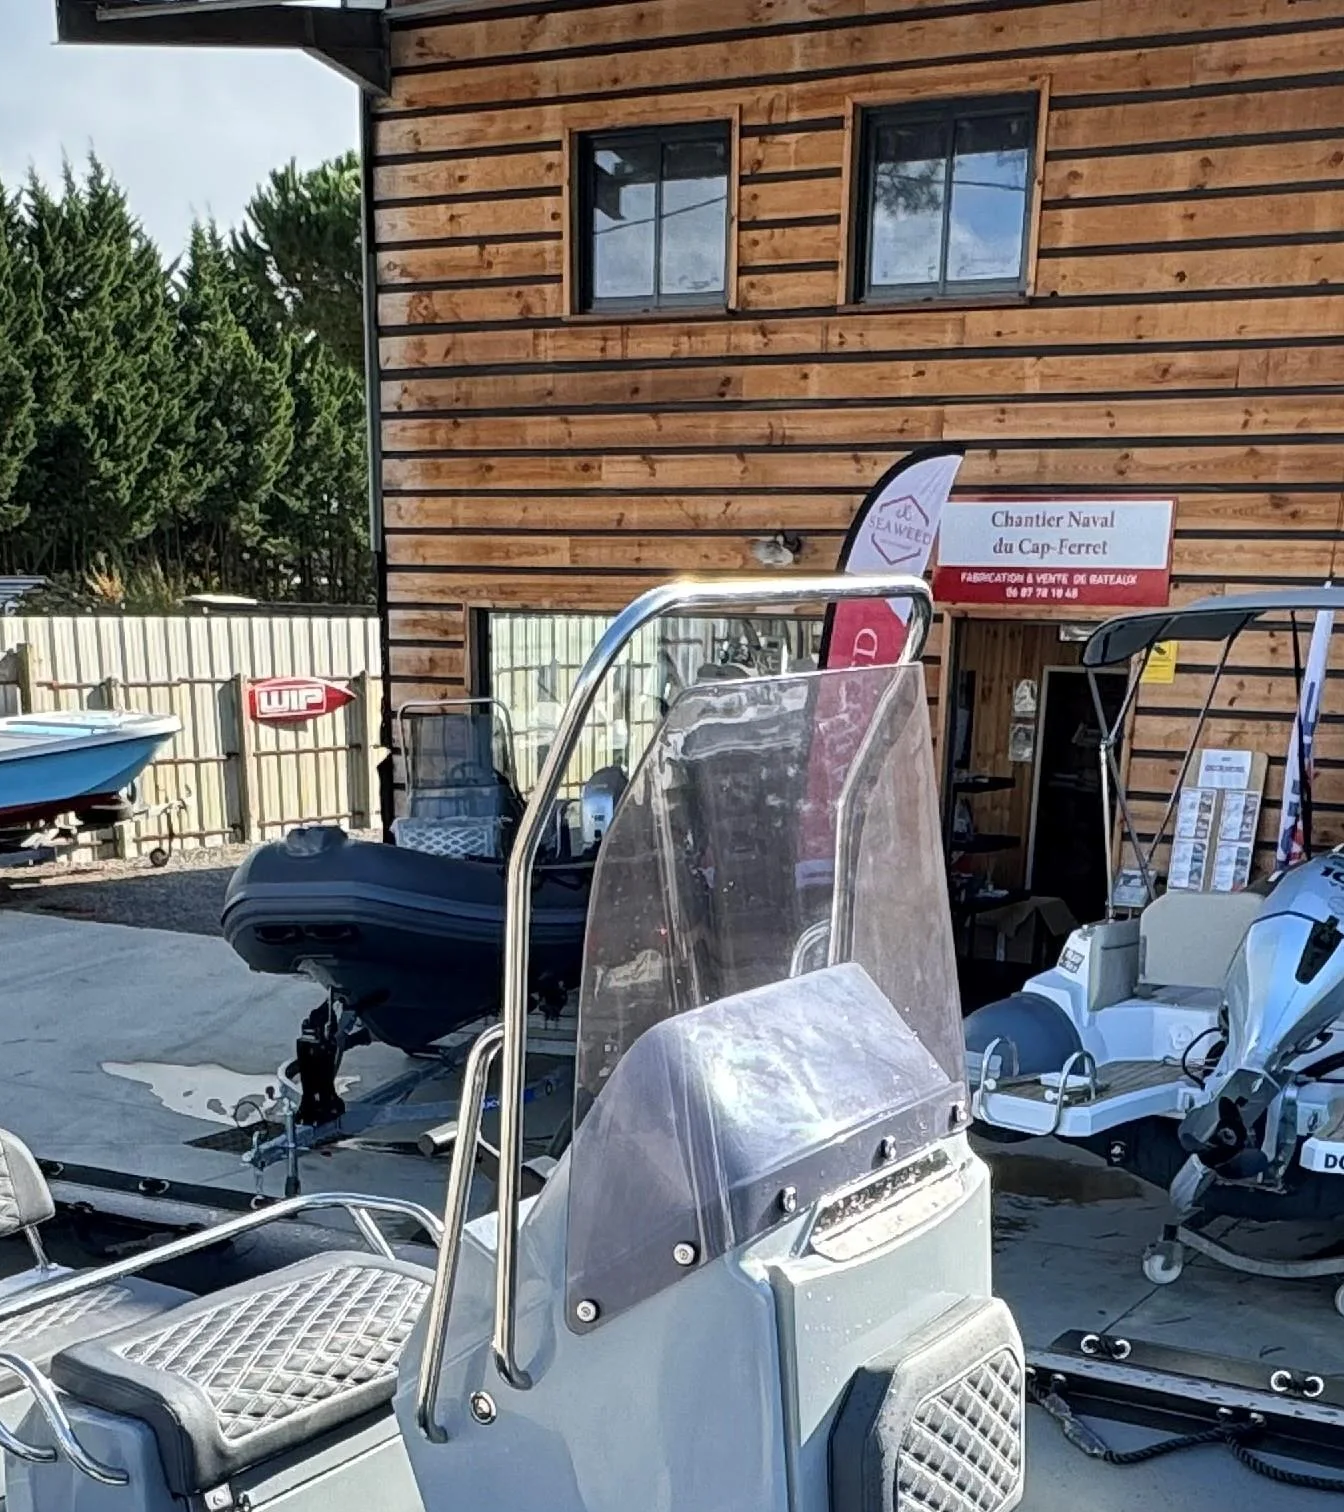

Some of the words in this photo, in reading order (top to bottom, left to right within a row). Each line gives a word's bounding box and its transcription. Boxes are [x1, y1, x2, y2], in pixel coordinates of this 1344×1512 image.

[991, 510, 1064, 528] Chantier
[1067, 510, 1115, 528] Naval
[867, 516, 932, 546] SEAWEED
[992, 537, 1014, 554] du
[1018, 538, 1108, 560] Cap-Ferret
[960, 572, 1024, 584] FABRICATION
[1036, 573, 1068, 584] VENTE
[1073, 574, 1087, 584] DE
[1089, 574, 1138, 585] BATEAUX
[259, 688, 324, 713] WIP
